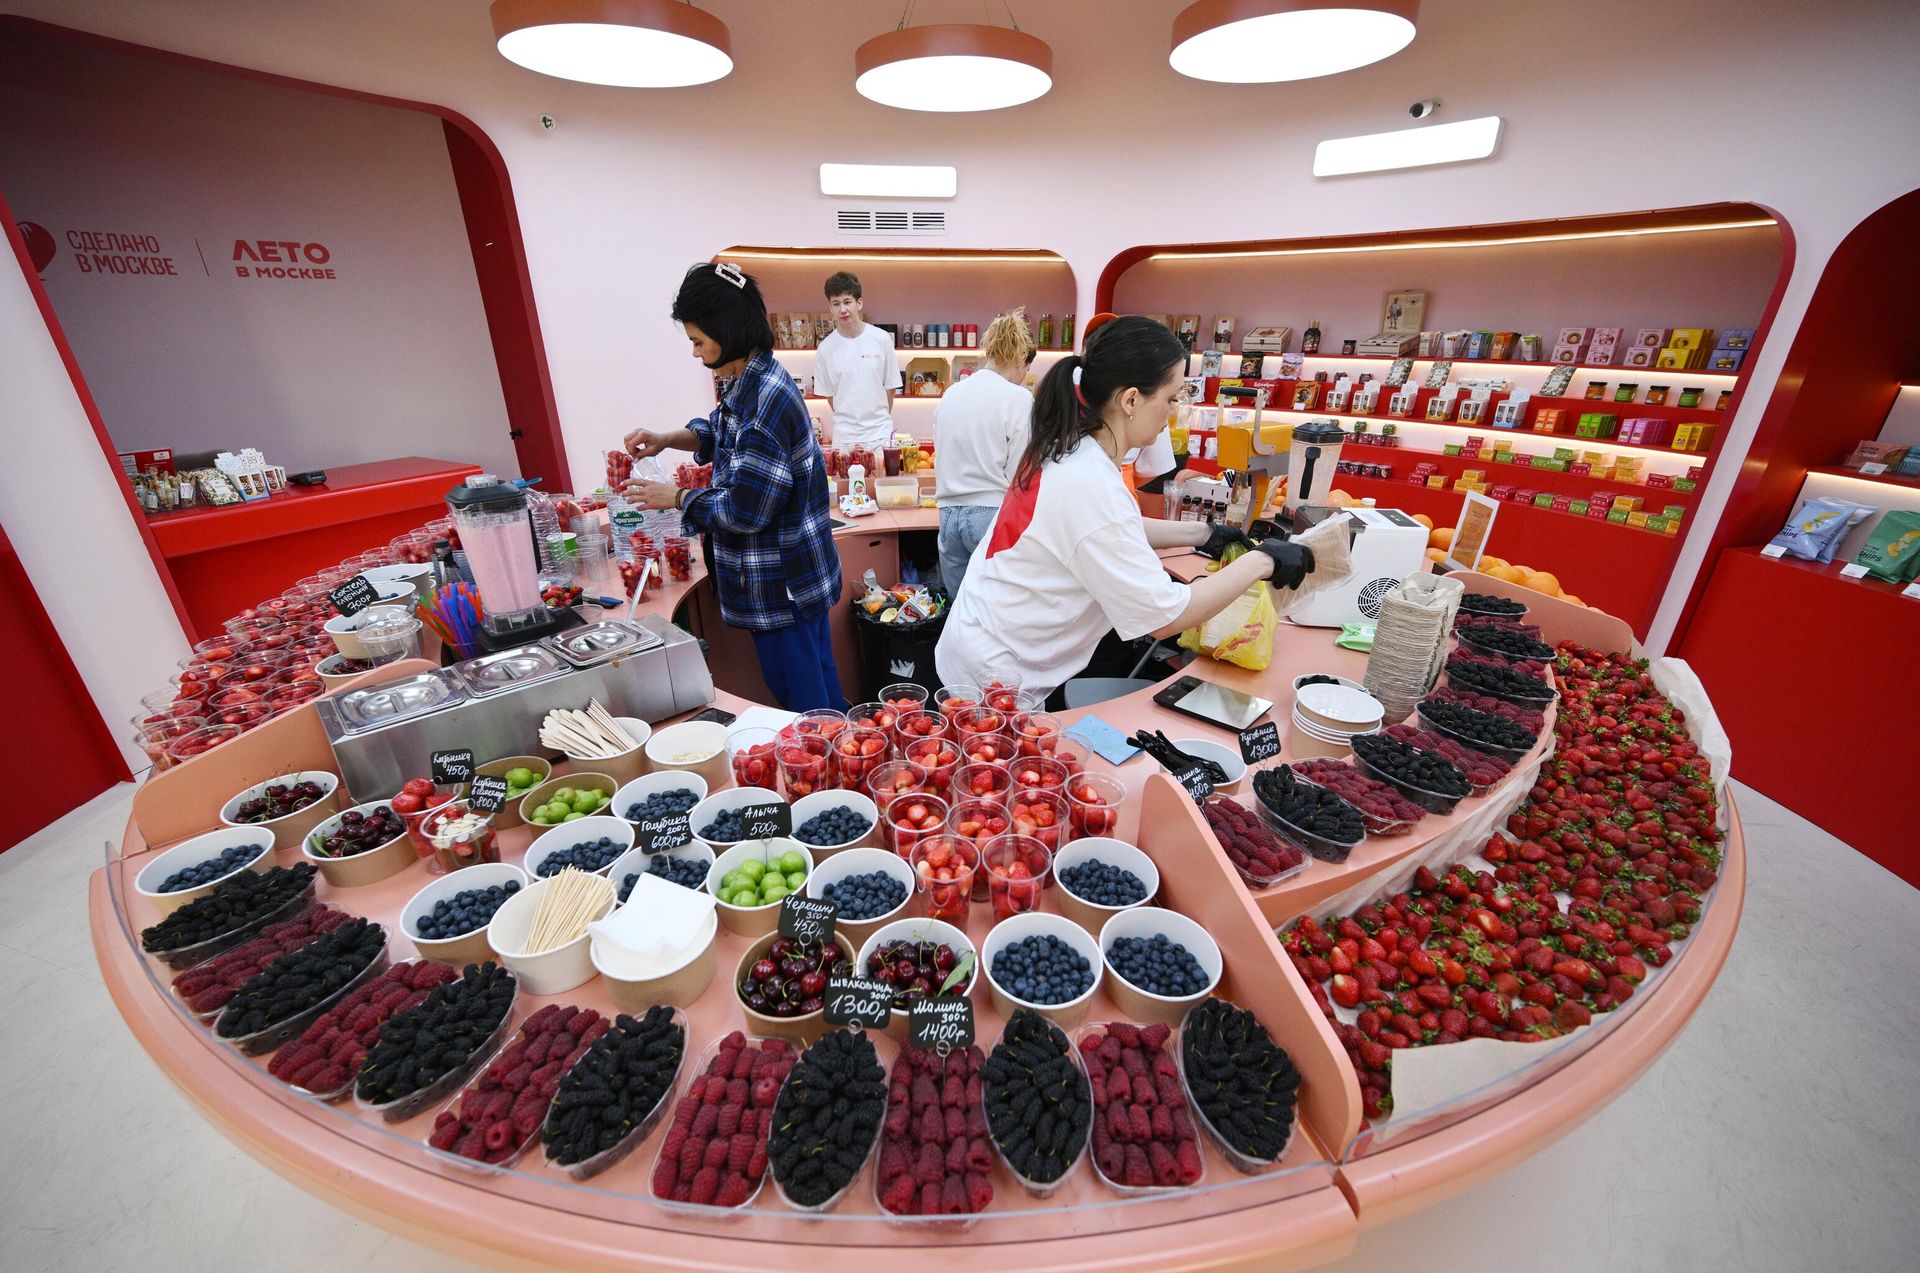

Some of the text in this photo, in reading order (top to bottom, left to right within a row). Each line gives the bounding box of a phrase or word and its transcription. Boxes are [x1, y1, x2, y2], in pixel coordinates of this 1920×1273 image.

[66, 230, 160, 254] СДЕЛАНО
[232, 239, 331, 265] ЛЕТО
[75, 253, 178, 276] В МОСКВЕ
[235, 266, 337, 280] В МОСКВЕ
[1174, 767, 1201, 783] алина
[641, 815, 690, 833] Голубика
[785, 896, 835, 917] Черешня
[913, 999, 969, 1015] Малина
